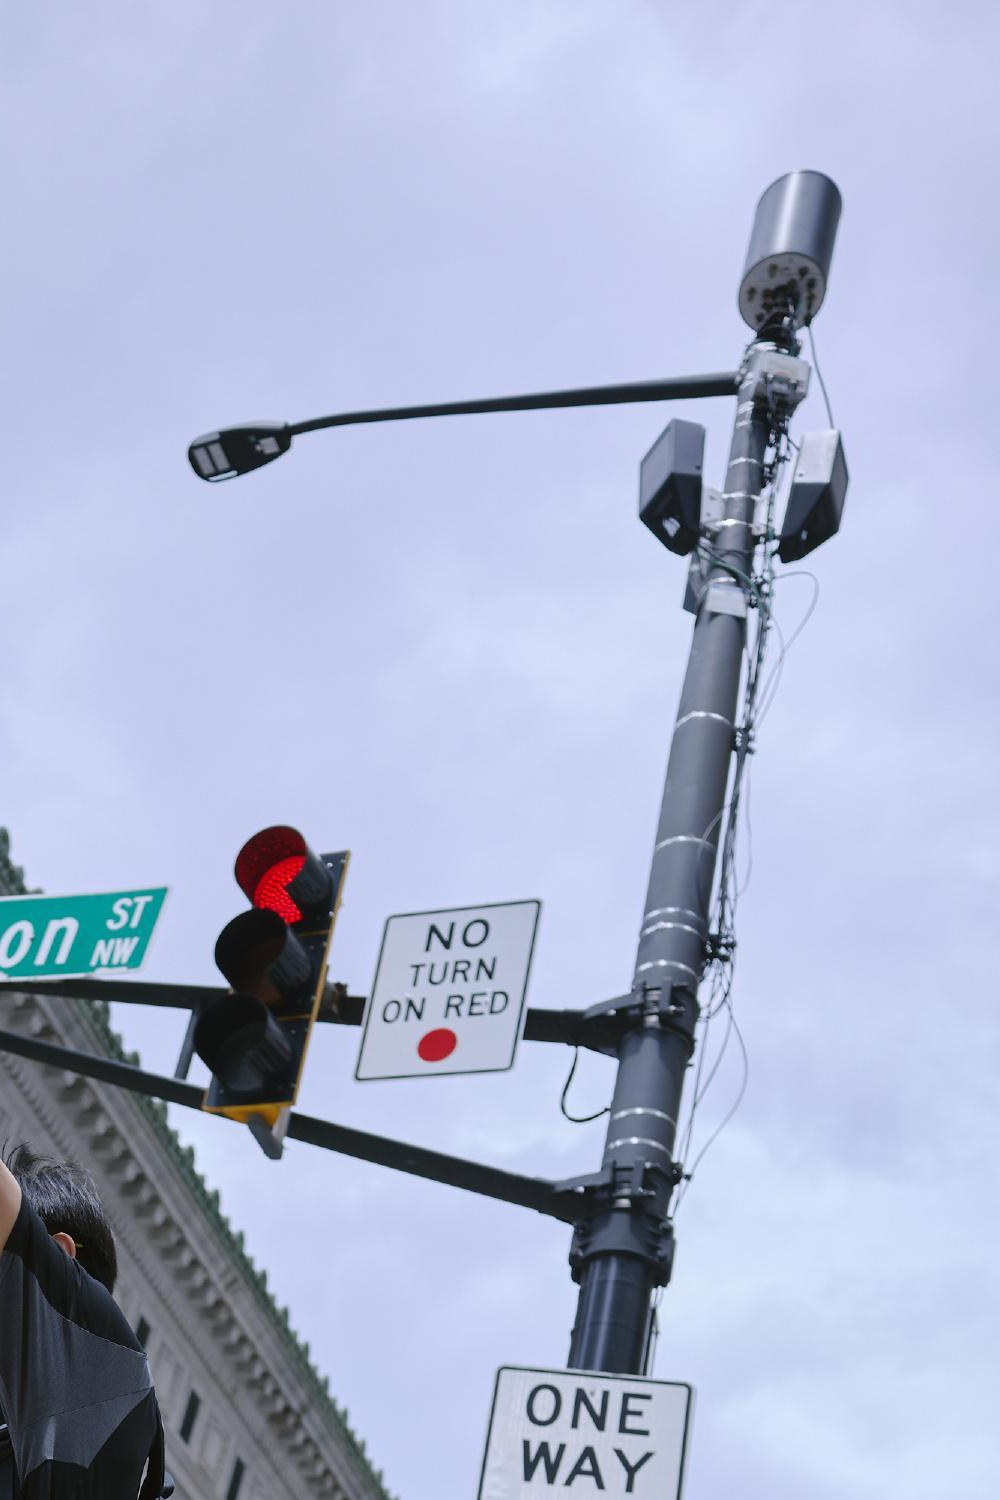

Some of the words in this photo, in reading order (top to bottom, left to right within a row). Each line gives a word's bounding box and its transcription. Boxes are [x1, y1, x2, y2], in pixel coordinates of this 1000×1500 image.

[106, 895, 153, 930] ST
[89, 936, 139, 967] NW
[425, 919, 489, 952] NO
[410, 956, 497, 987] TURN
[382, 998, 426, 1023] ON
[444, 991, 509, 1018] RED
[526, 1384, 652, 1436] ONE
[522, 1439, 655, 1493] WAY
